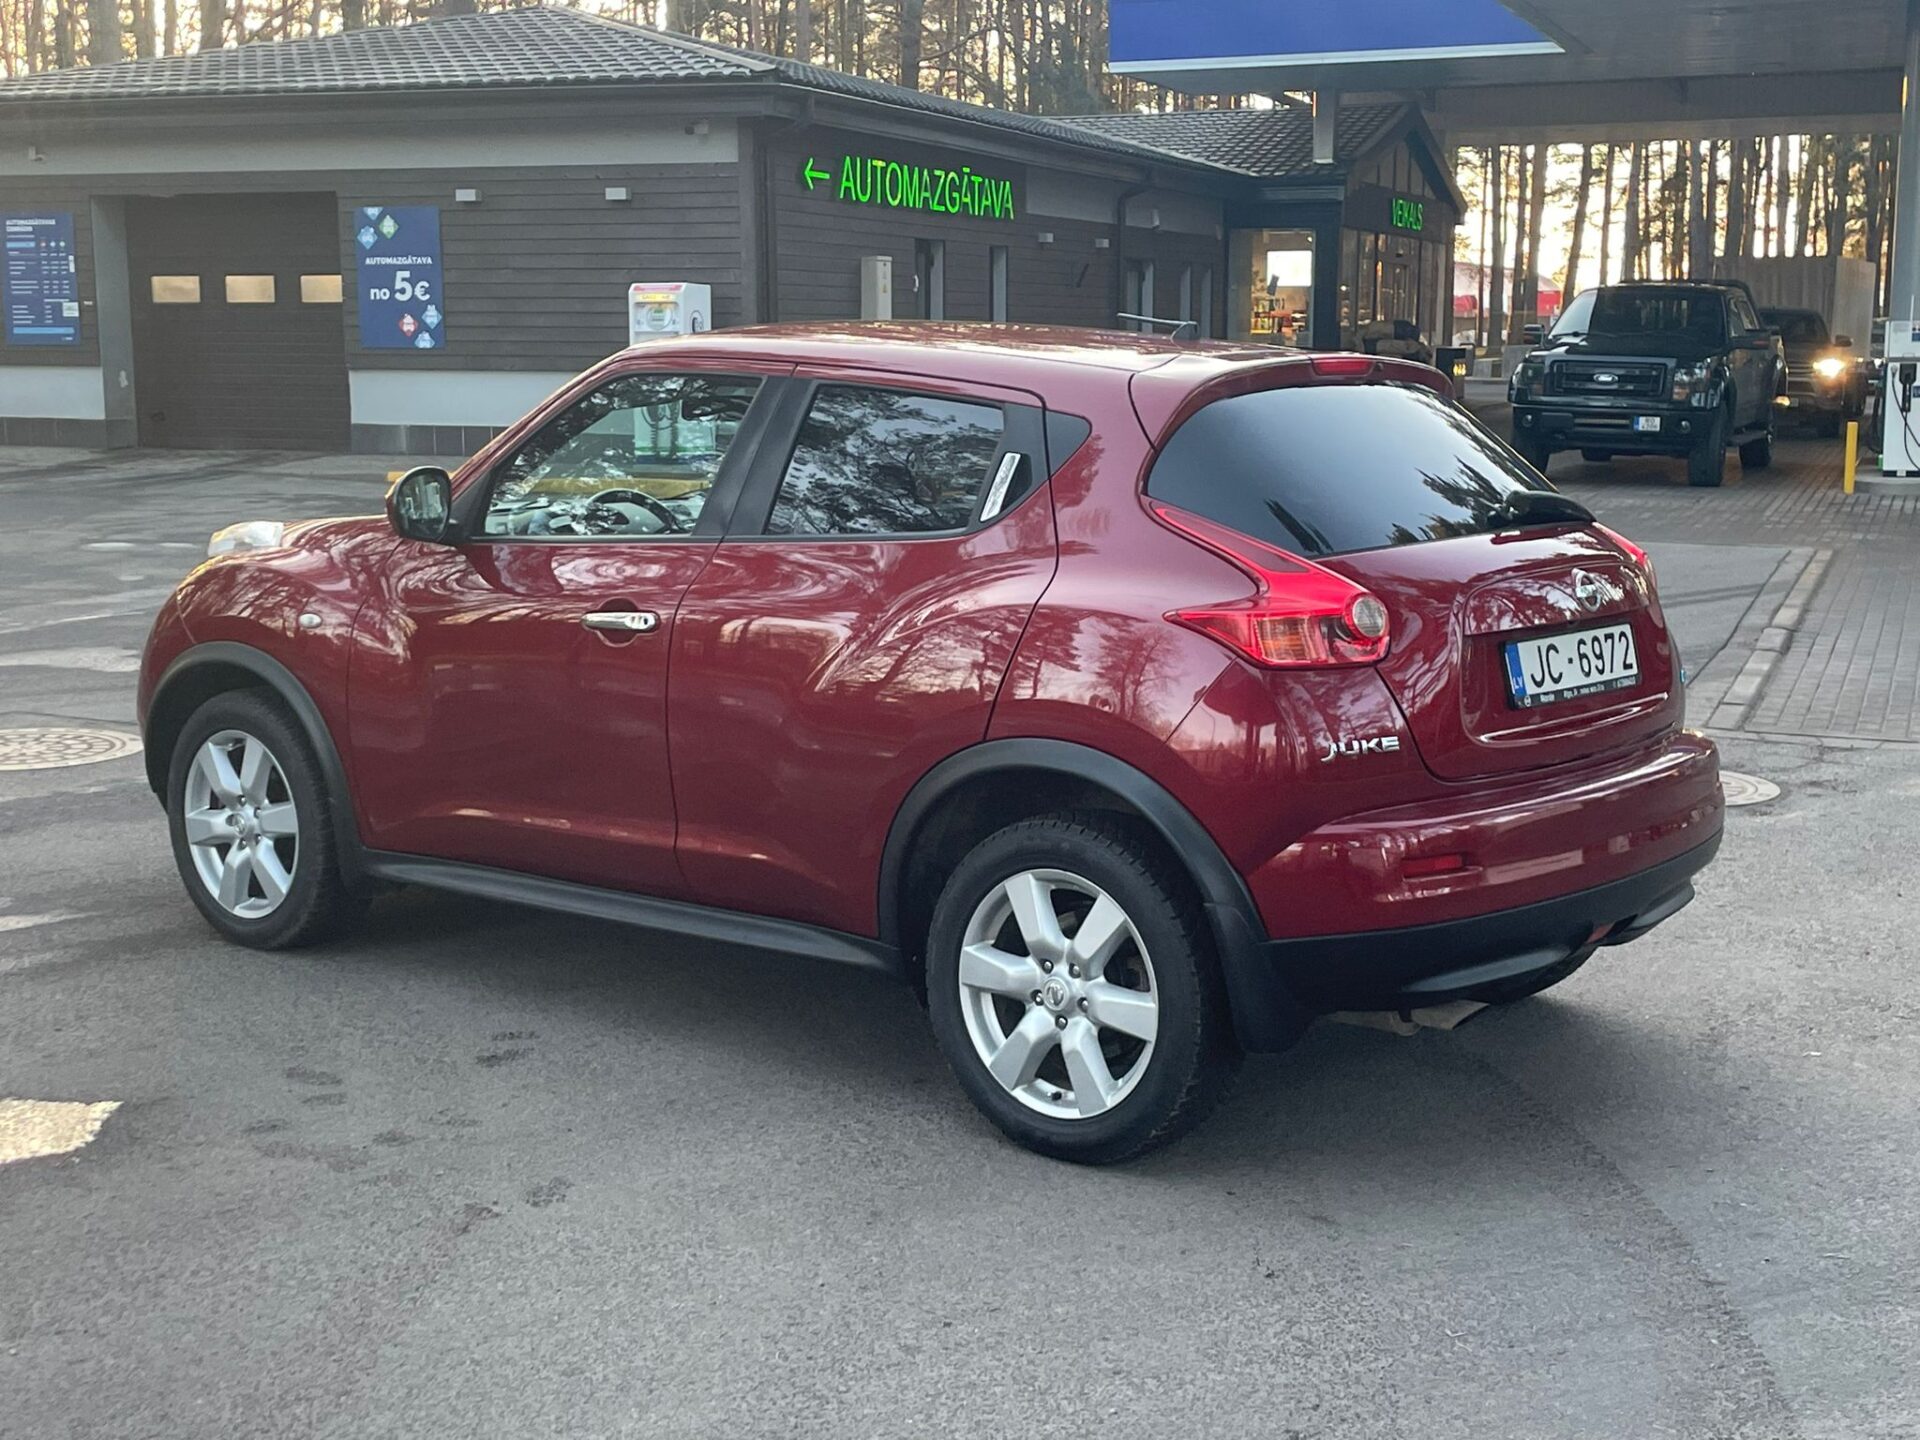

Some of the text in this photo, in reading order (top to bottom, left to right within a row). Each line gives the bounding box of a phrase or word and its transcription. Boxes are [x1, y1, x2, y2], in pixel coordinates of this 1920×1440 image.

[839, 155, 1014, 220] AUTOMAZGĀTAVA
[365, 254, 433, 265] AUTOMAZGĀTAVA
[370, 270, 431, 301] no 5€
[1513, 676, 1523, 690] LV
[1320, 736, 1400, 762] JUKE
